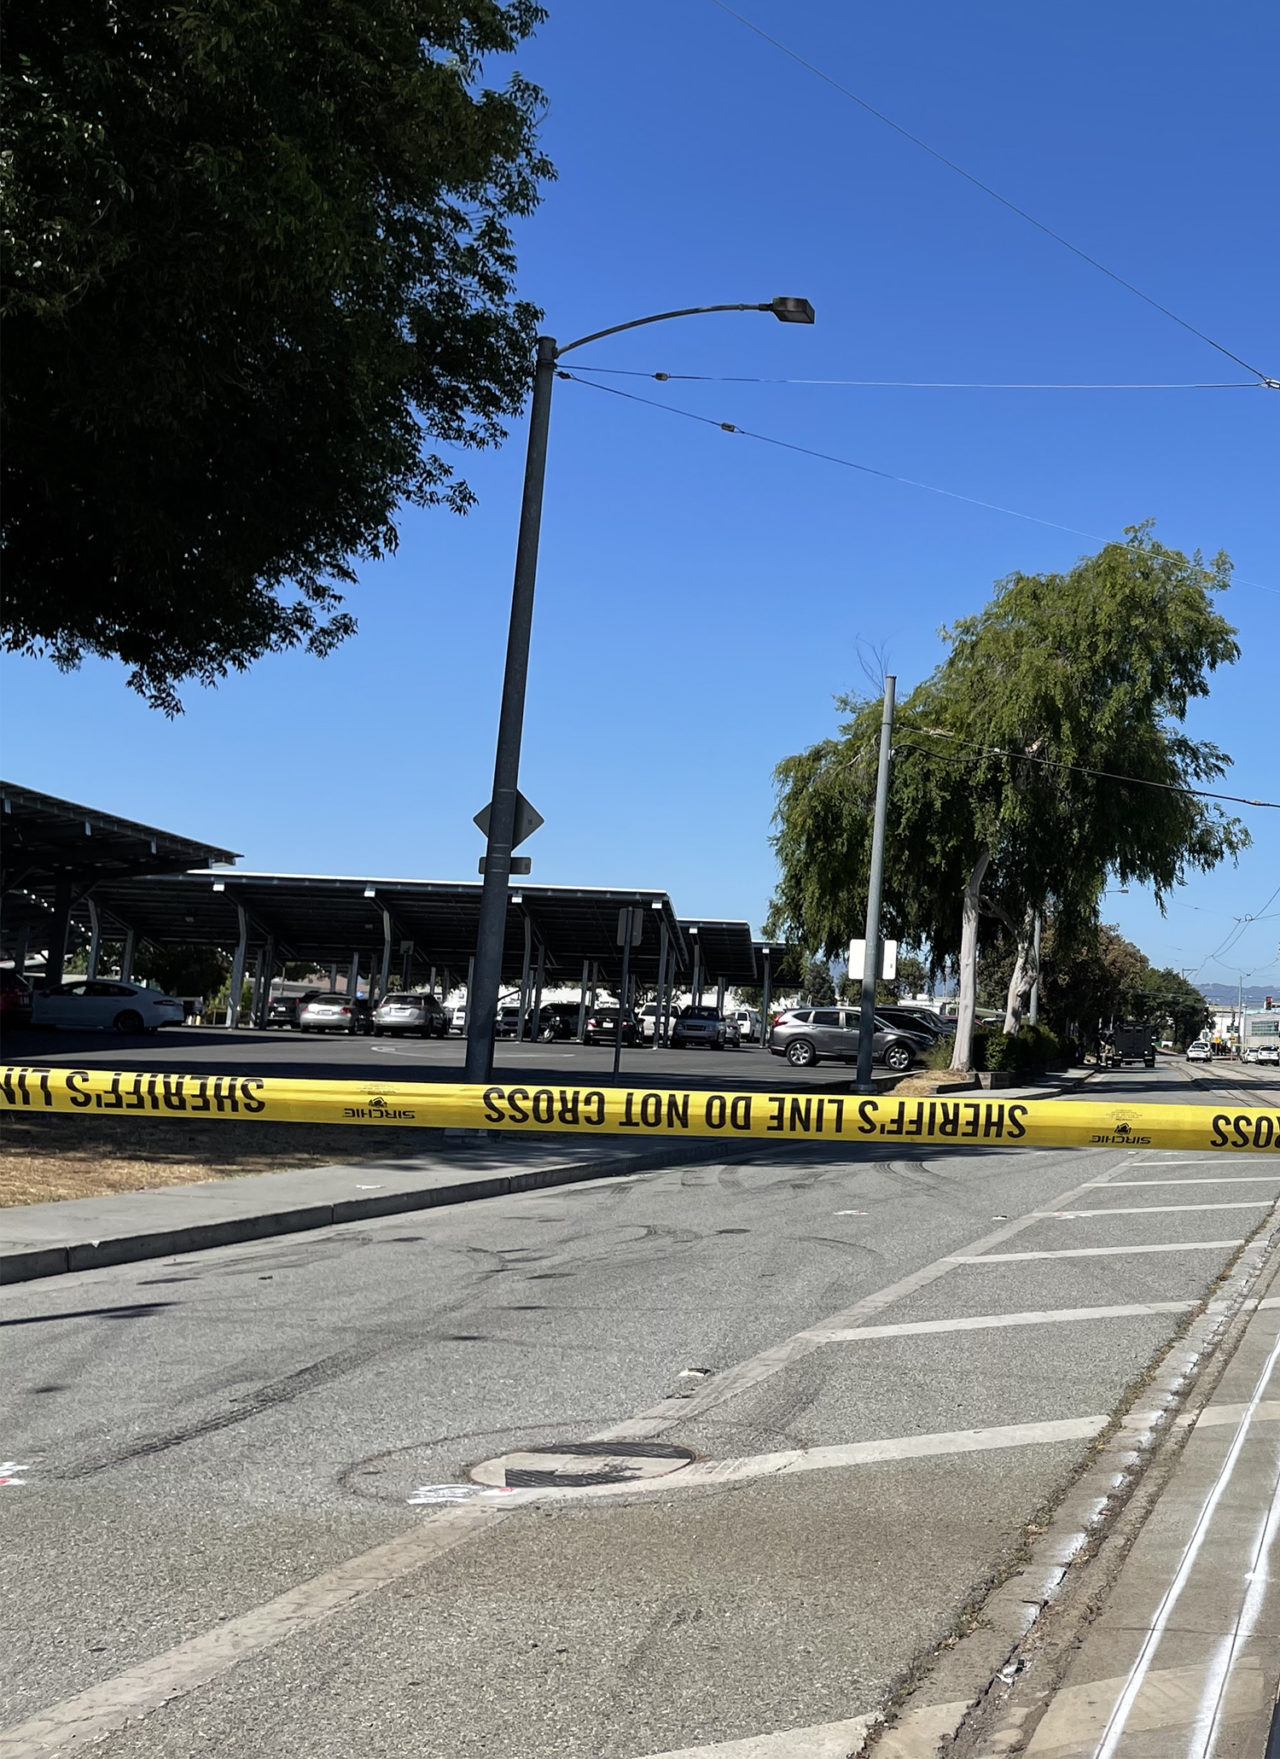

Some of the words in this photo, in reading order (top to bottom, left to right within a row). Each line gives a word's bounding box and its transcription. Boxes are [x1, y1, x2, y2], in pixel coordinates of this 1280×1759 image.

[66, 1070, 266, 1114] SHERIFF'S
[483, 1086, 606, 1126] CROSS
[618, 1092, 690, 1129] NOT
[342, 1108, 416, 1119] SIRCHIE
[705, 1095, 752, 1131] DO
[766, 1096, 844, 1134] LINE
[857, 1100, 1028, 1139] SHERIFF'S
